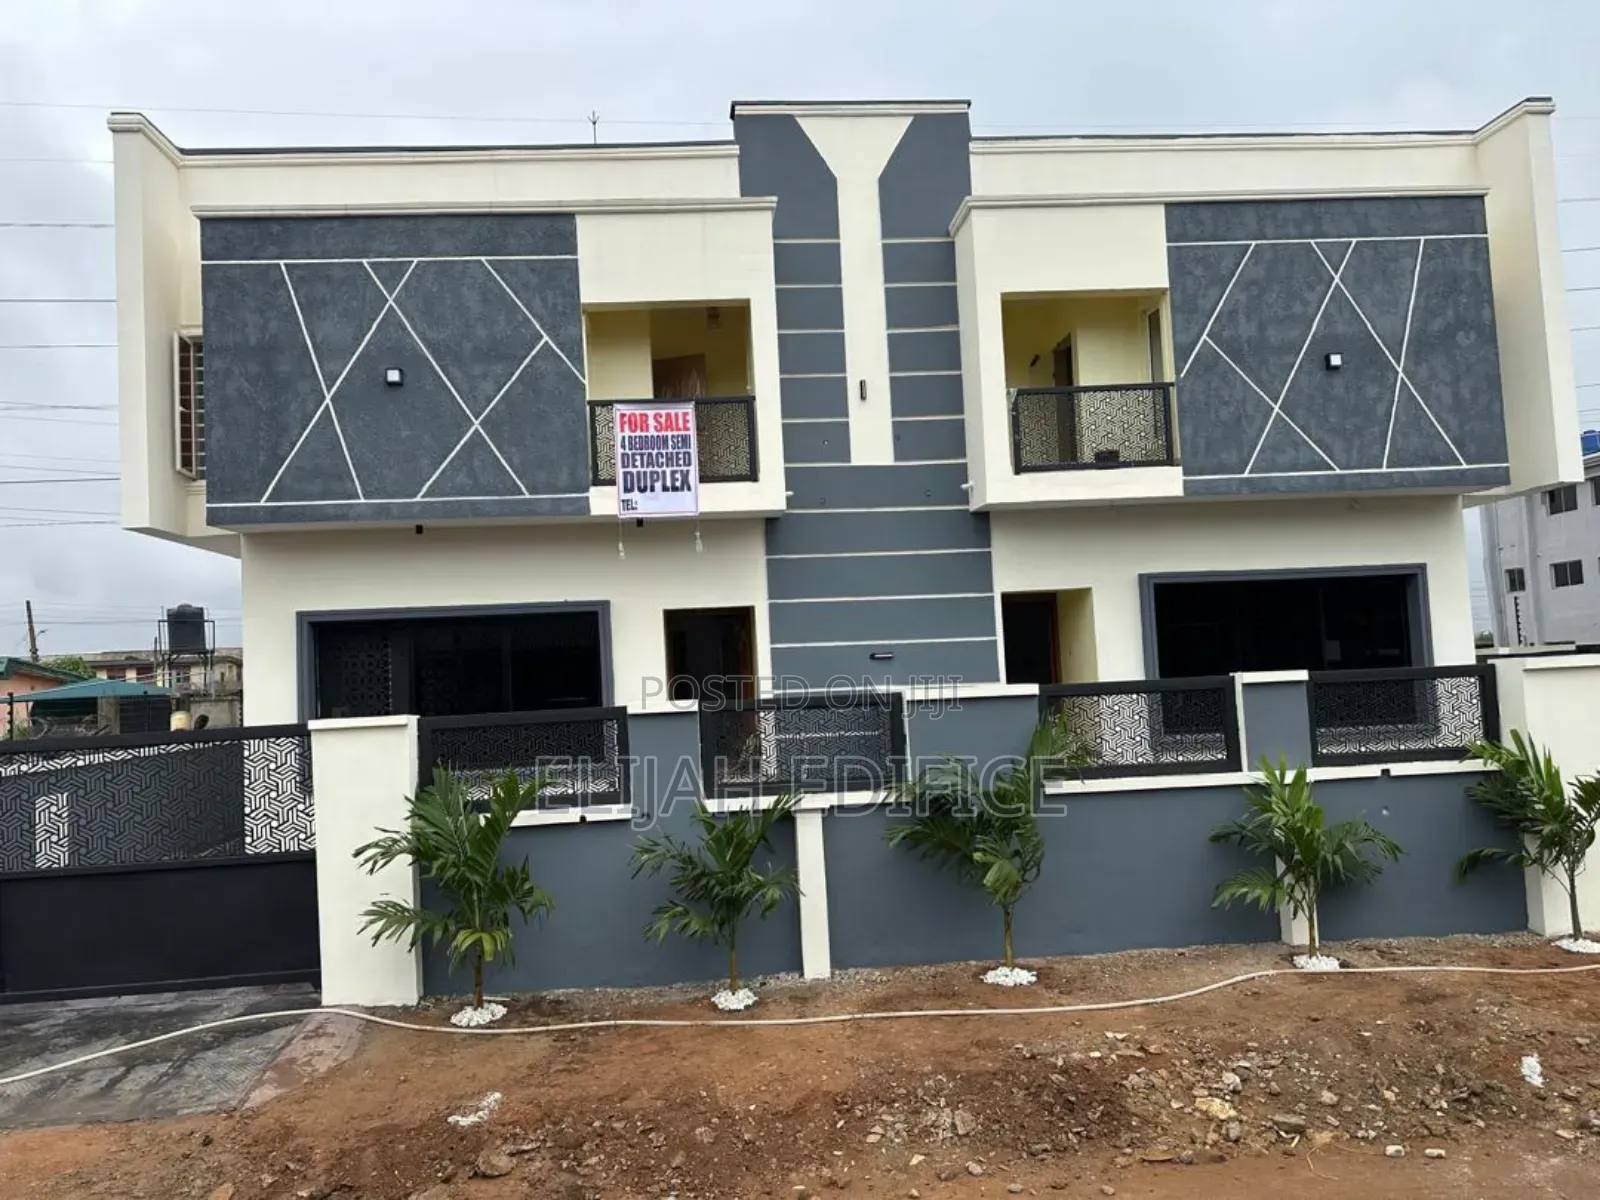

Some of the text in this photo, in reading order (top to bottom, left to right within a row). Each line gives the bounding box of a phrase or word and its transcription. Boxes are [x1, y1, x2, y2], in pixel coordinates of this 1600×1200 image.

[619, 411, 691, 433] FOR SALE
[620, 433, 692, 451] 4 BEDROOM SEMI
[620, 451, 692, 469] DETACHED
[623, 469, 692, 494] DUPLEX
[621, 498, 638, 512] TEL:
